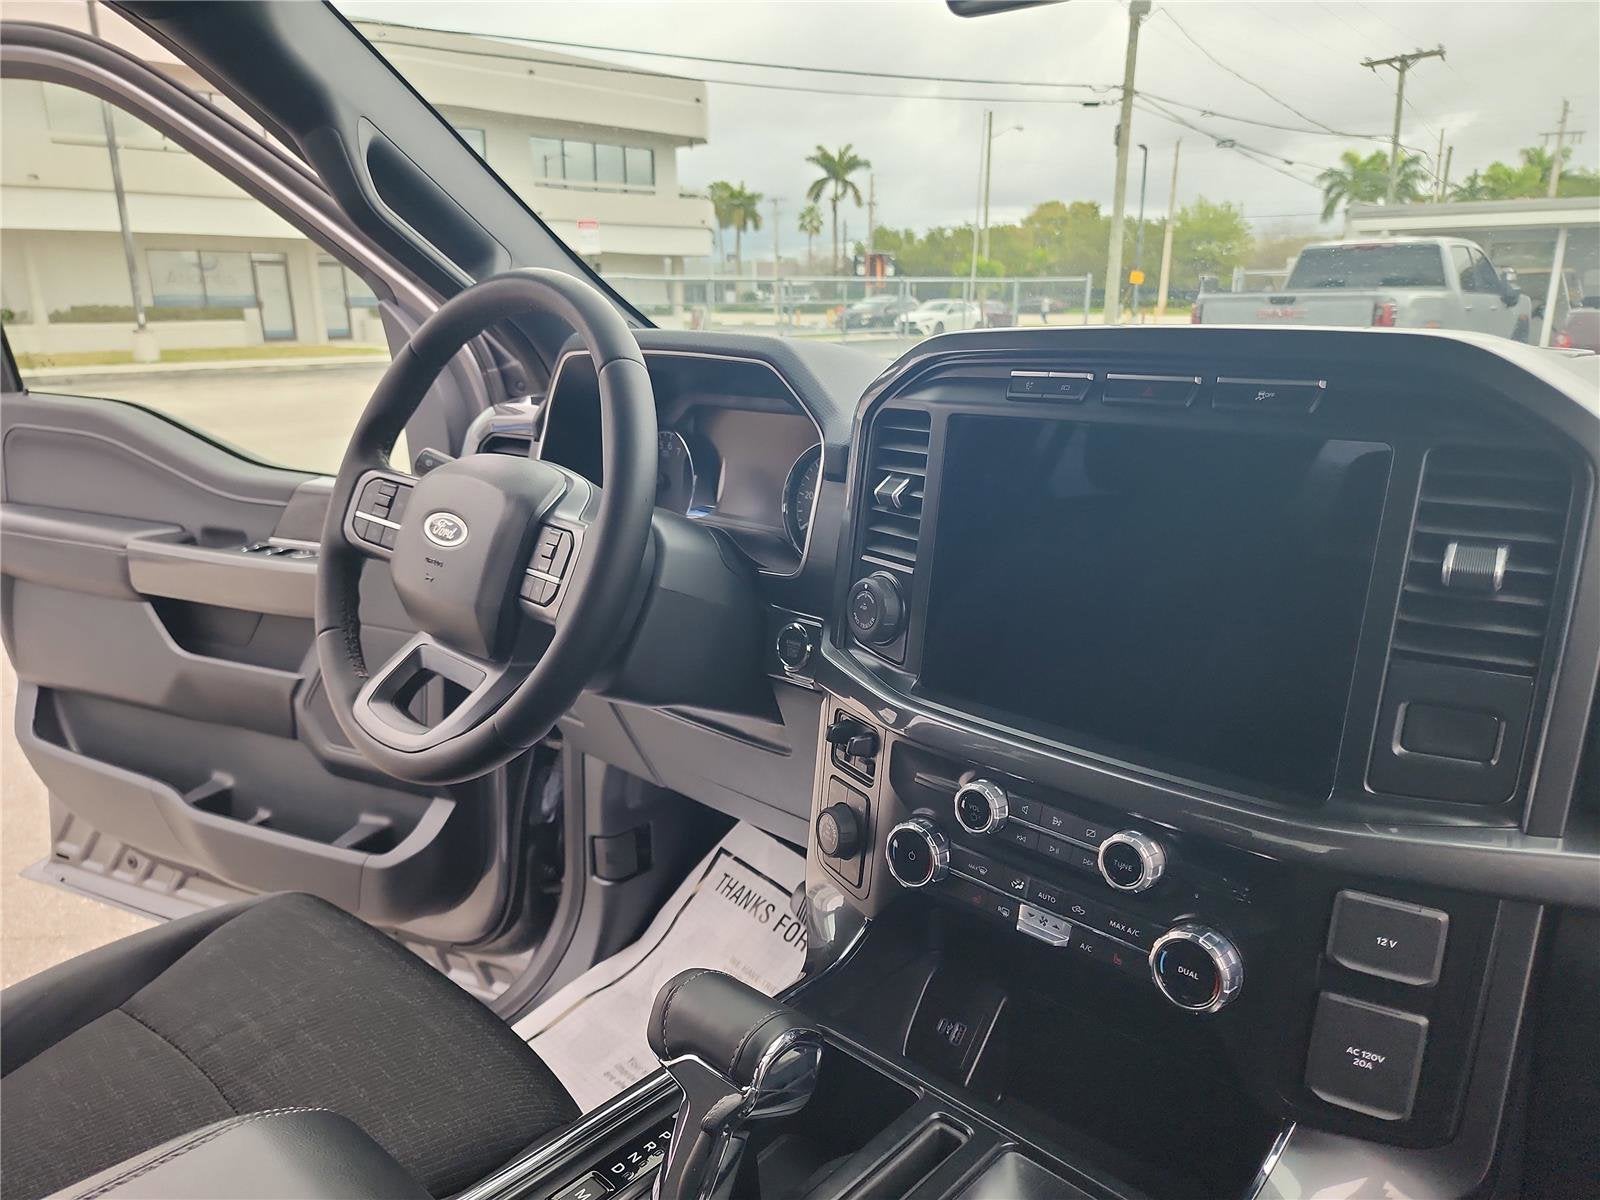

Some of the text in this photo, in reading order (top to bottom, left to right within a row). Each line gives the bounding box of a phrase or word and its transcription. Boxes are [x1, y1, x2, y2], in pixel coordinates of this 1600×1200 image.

[430, 519, 459, 540] Ford
[1113, 859, 1133, 872] TUNE
[715, 872, 776, 924] THANKS
[1038, 891, 1056, 904] AUTO
[1109, 920, 1140, 938] MAX A/C
[1079, 942, 1093, 953] A/C
[1376, 936, 1398, 948] 12 V
[1177, 965, 1199, 980] DUAL
[1345, 1046, 1386, 1063] AC 120V
[1352, 1057, 1373, 1070] 20A
[658, 1130, 671, 1139] P
[643, 1141, 657, 1152] R
[627, 1151, 643, 1163] N
[610, 1162, 625, 1174] D
[574, 1188, 592, 1200] M
